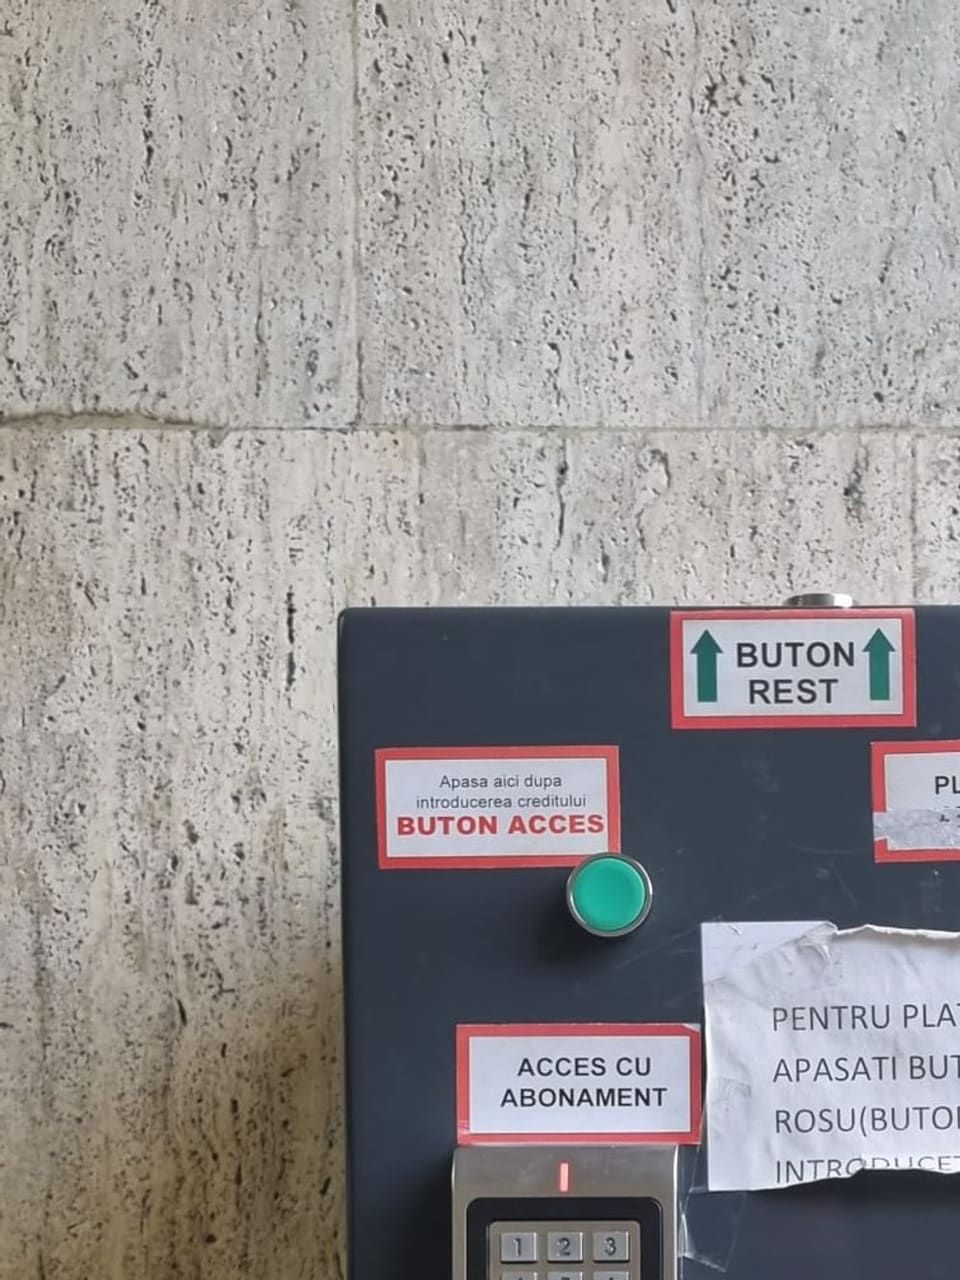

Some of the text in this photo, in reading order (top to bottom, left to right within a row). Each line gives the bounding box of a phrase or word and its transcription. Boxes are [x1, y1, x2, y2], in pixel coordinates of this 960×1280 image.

[736, 641, 855, 668] BUTON
[749, 678, 838, 704] REST
[440, 774, 562, 791] Apasa aici dupa
[416, 793, 586, 809] introducerea creditului
[397, 814, 605, 836] BUTON ACCES
[772, 1004, 890, 1031] PENTRU
[517, 1056, 651, 1076] ACCES CU
[773, 1056, 898, 1083] APASATI
[501, 1087, 667, 1107] ABONAMENT
[513, 1238, 523, 1256] 1
[558, 1238, 571, 1256] 2
[604, 1237, 617, 1256] 3
